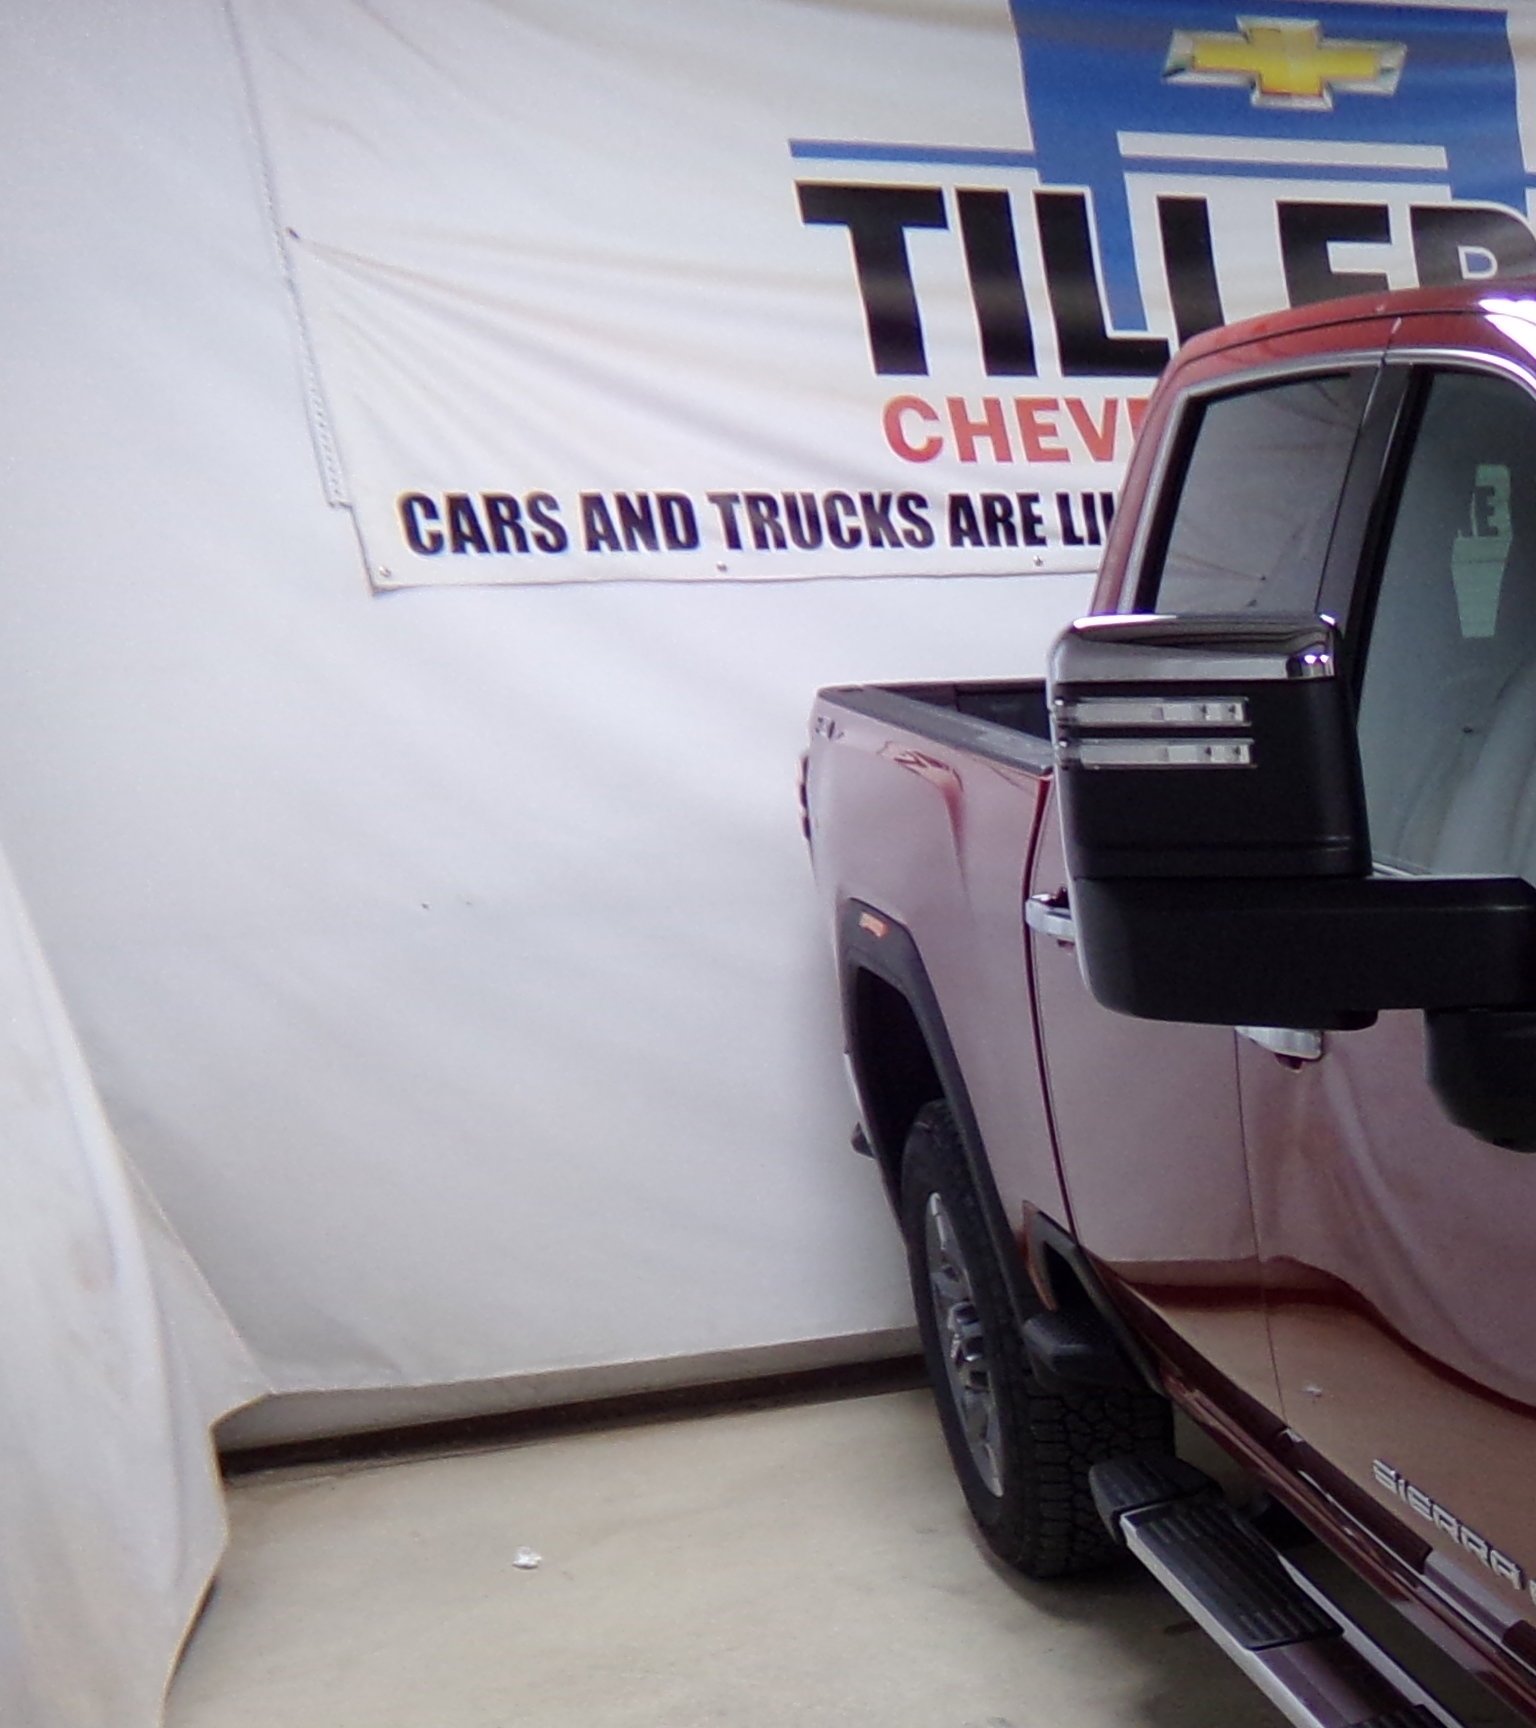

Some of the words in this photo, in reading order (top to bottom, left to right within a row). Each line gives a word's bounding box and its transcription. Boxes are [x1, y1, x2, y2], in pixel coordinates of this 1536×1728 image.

[882, 395, 1150, 462] CHEV
[400, 491, 568, 555] CARS
[579, 491, 700, 551] AND
[706, 490, 934, 550] TRUCKS
[948, 492, 1048, 547] ARE
[1373, 1459, 1521, 1590] SIERRA
